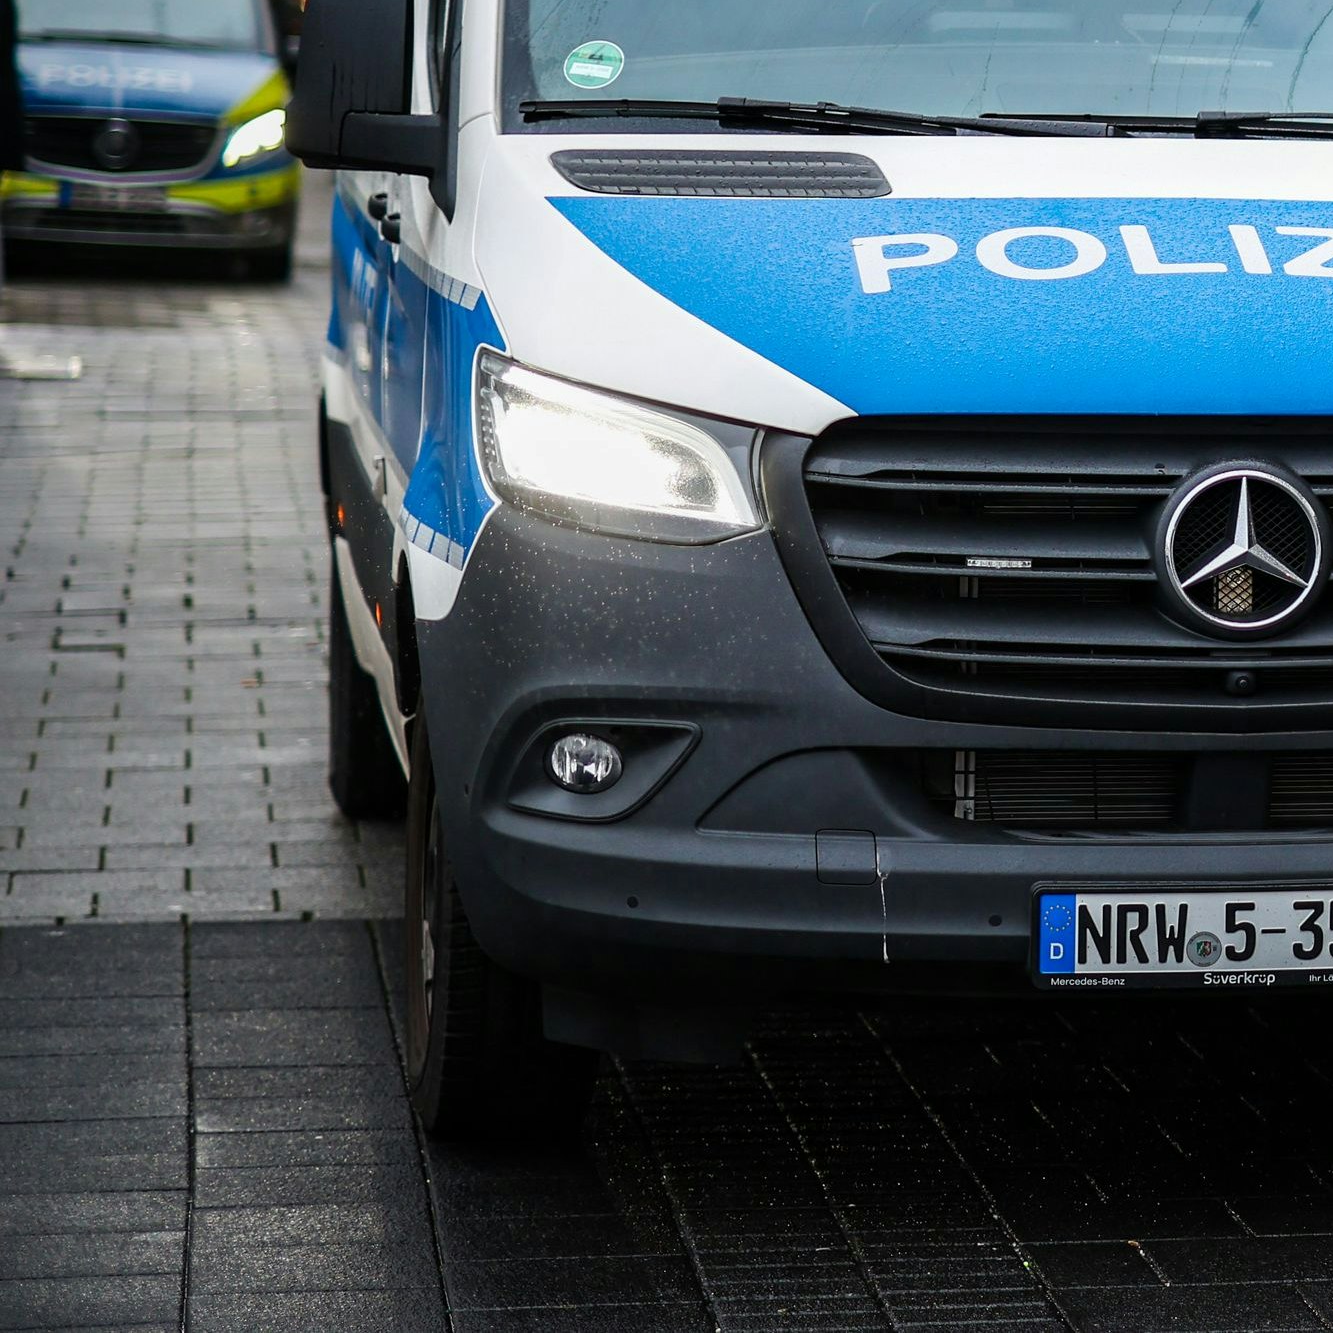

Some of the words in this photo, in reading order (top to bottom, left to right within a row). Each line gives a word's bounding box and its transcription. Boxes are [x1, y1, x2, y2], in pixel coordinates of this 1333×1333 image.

[38, 63, 194, 94] POLIZEI
[1077, 902, 1189, 965] NRW
[1049, 942, 1064, 960] D
[1050, 976, 1126, 987] Mercedes-Benz
[1203, 972, 1276, 986] Süverkrüp
[1309, 974, 1321, 983] Ihr
